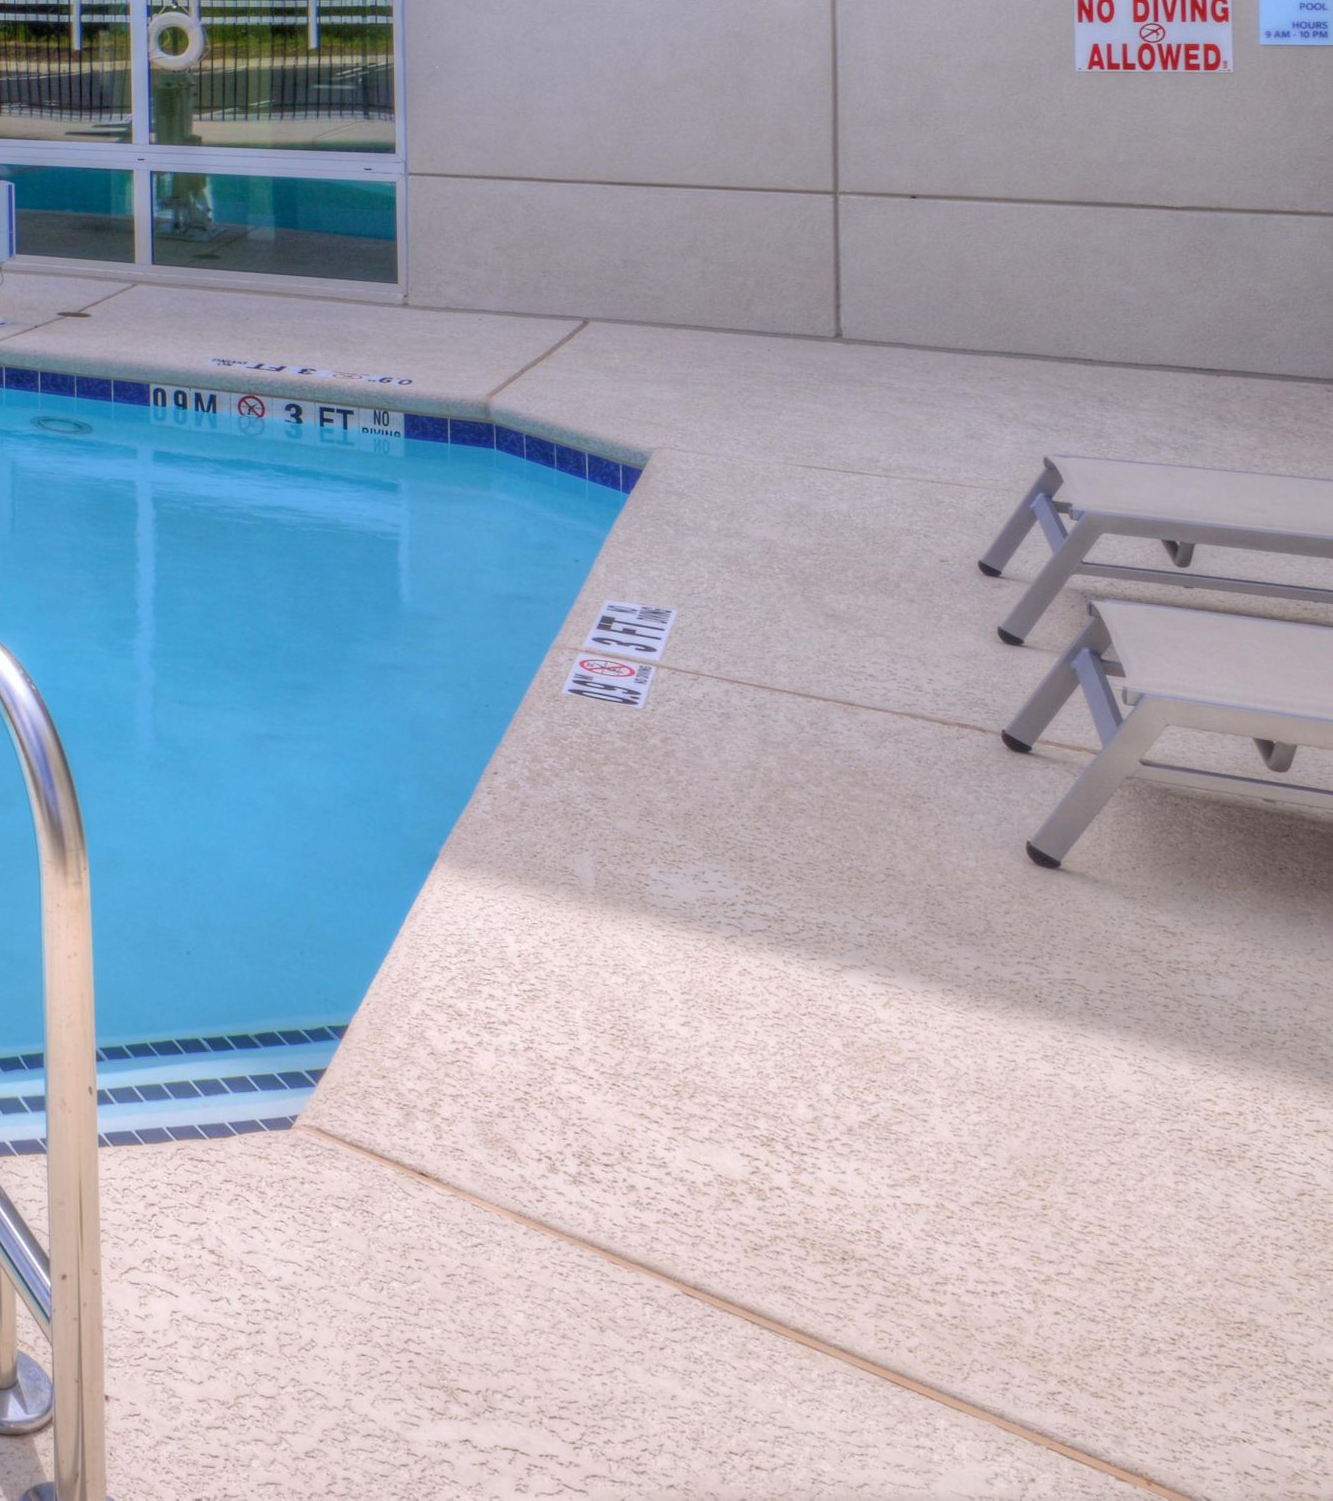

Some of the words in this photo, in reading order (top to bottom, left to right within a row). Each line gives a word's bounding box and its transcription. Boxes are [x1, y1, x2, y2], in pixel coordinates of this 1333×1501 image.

[1299, 2, 1328, 11] POOL
[1265, 30, 1271, 38] 9
[1274, 30, 1290, 38] AM
[1300, 30, 1310, 38] 10
[1312, 30, 1329, 38] PM
[1292, 21, 1328, 30] HOURS
[1087, 43, 1222, 71] ALLOWED
[194, 392, 217, 414] M
[284, 403, 303, 424] 3
[319, 406, 354, 430] FT
[372, 409, 390, 427] NO
[596, 615, 665, 640] FT
[591, 637, 658, 653] 3
